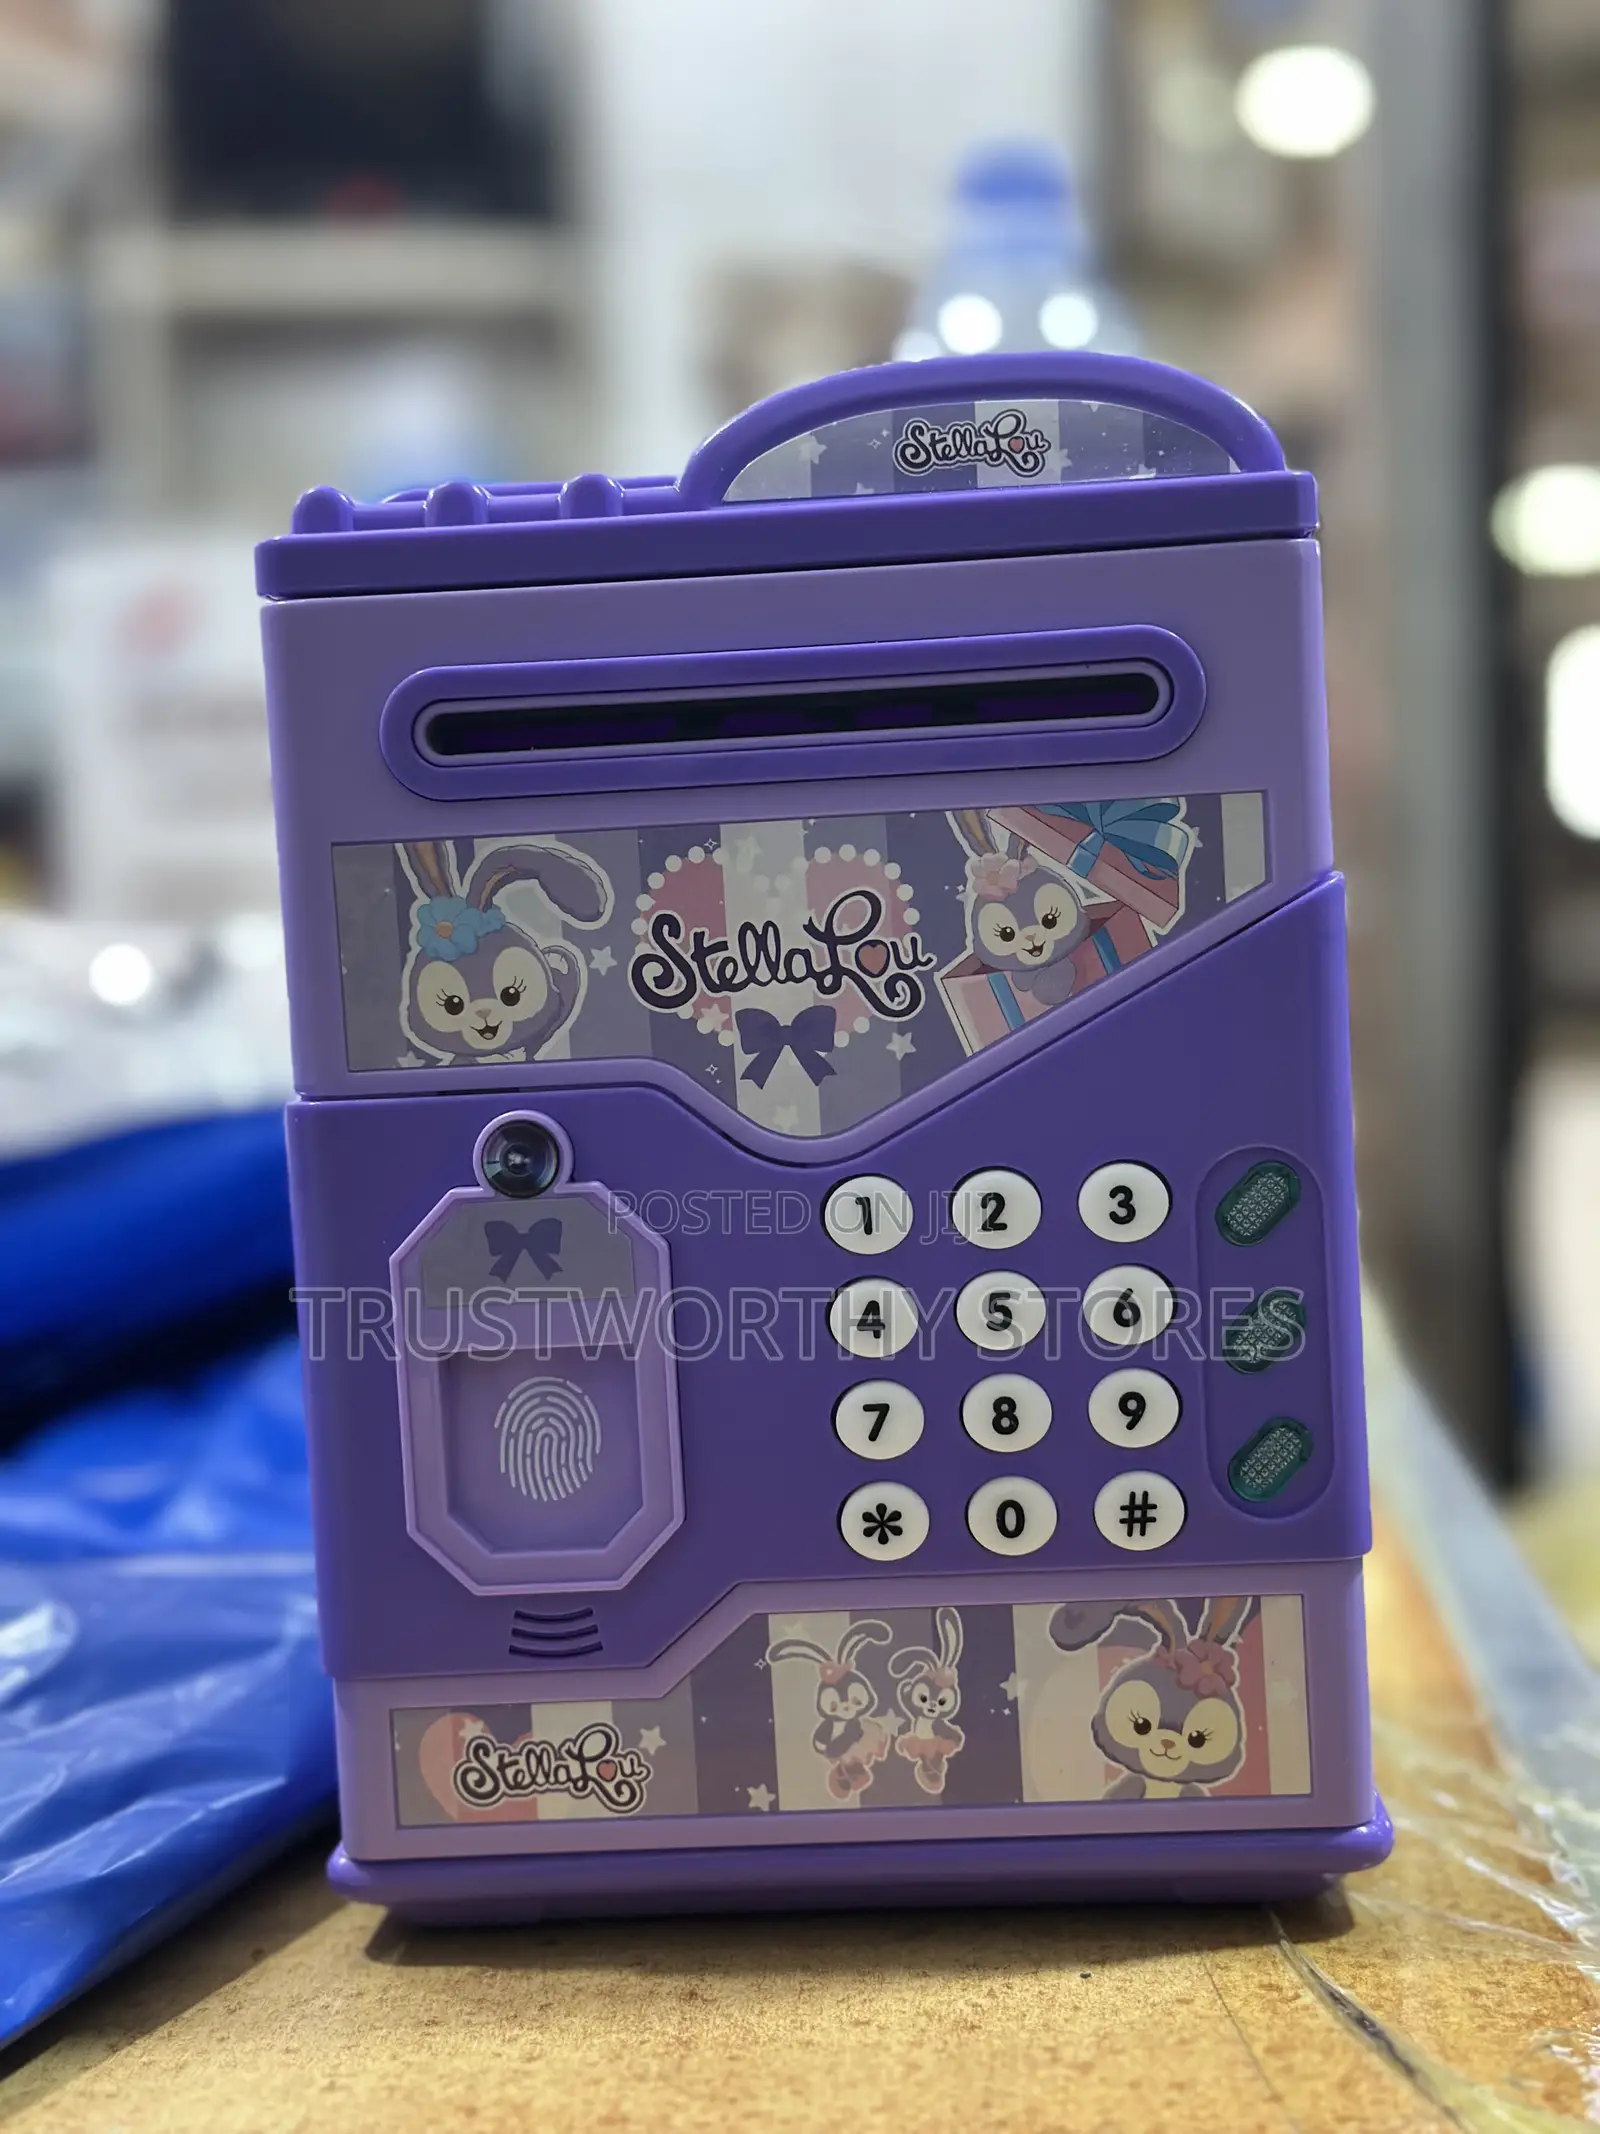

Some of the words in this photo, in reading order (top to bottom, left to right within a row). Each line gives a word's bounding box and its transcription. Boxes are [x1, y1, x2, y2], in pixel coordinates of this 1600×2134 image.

[854, 1195, 874, 1236] 1
[980, 1191, 1008, 1233] 2
[1108, 1184, 1137, 1226] 3
[856, 1299, 887, 1340] 4
[985, 1291, 1013, 1332] 5
[1112, 1287, 1142, 1328] 6
[862, 1402, 891, 1443] 7
[991, 1395, 1020, 1436] 8
[1117, 1390, 1147, 1431] 9
[995, 1498, 1026, 1540] 0
